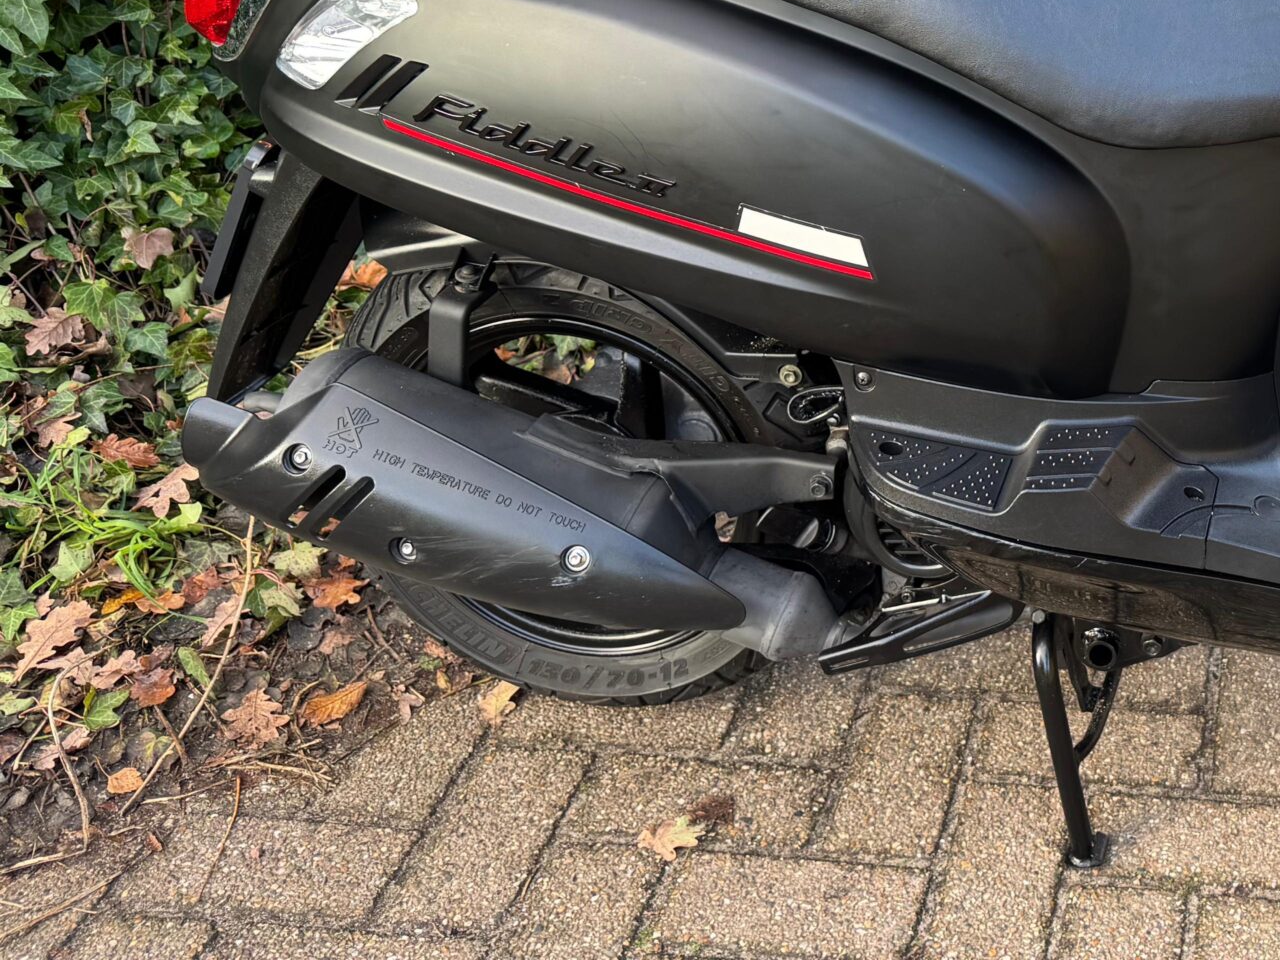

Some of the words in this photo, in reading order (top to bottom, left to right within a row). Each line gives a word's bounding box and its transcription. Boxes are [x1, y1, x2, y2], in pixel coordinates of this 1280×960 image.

[412, 93, 629, 187] Fiddle
[322, 438, 359, 459] HOT
[372, 447, 407, 470] HIGH
[410, 461, 492, 501] TEMPERATURE
[495, 493, 513, 508] DO
[516, 500, 544, 519] NOT
[549, 510, 588, 534] TOUCH
